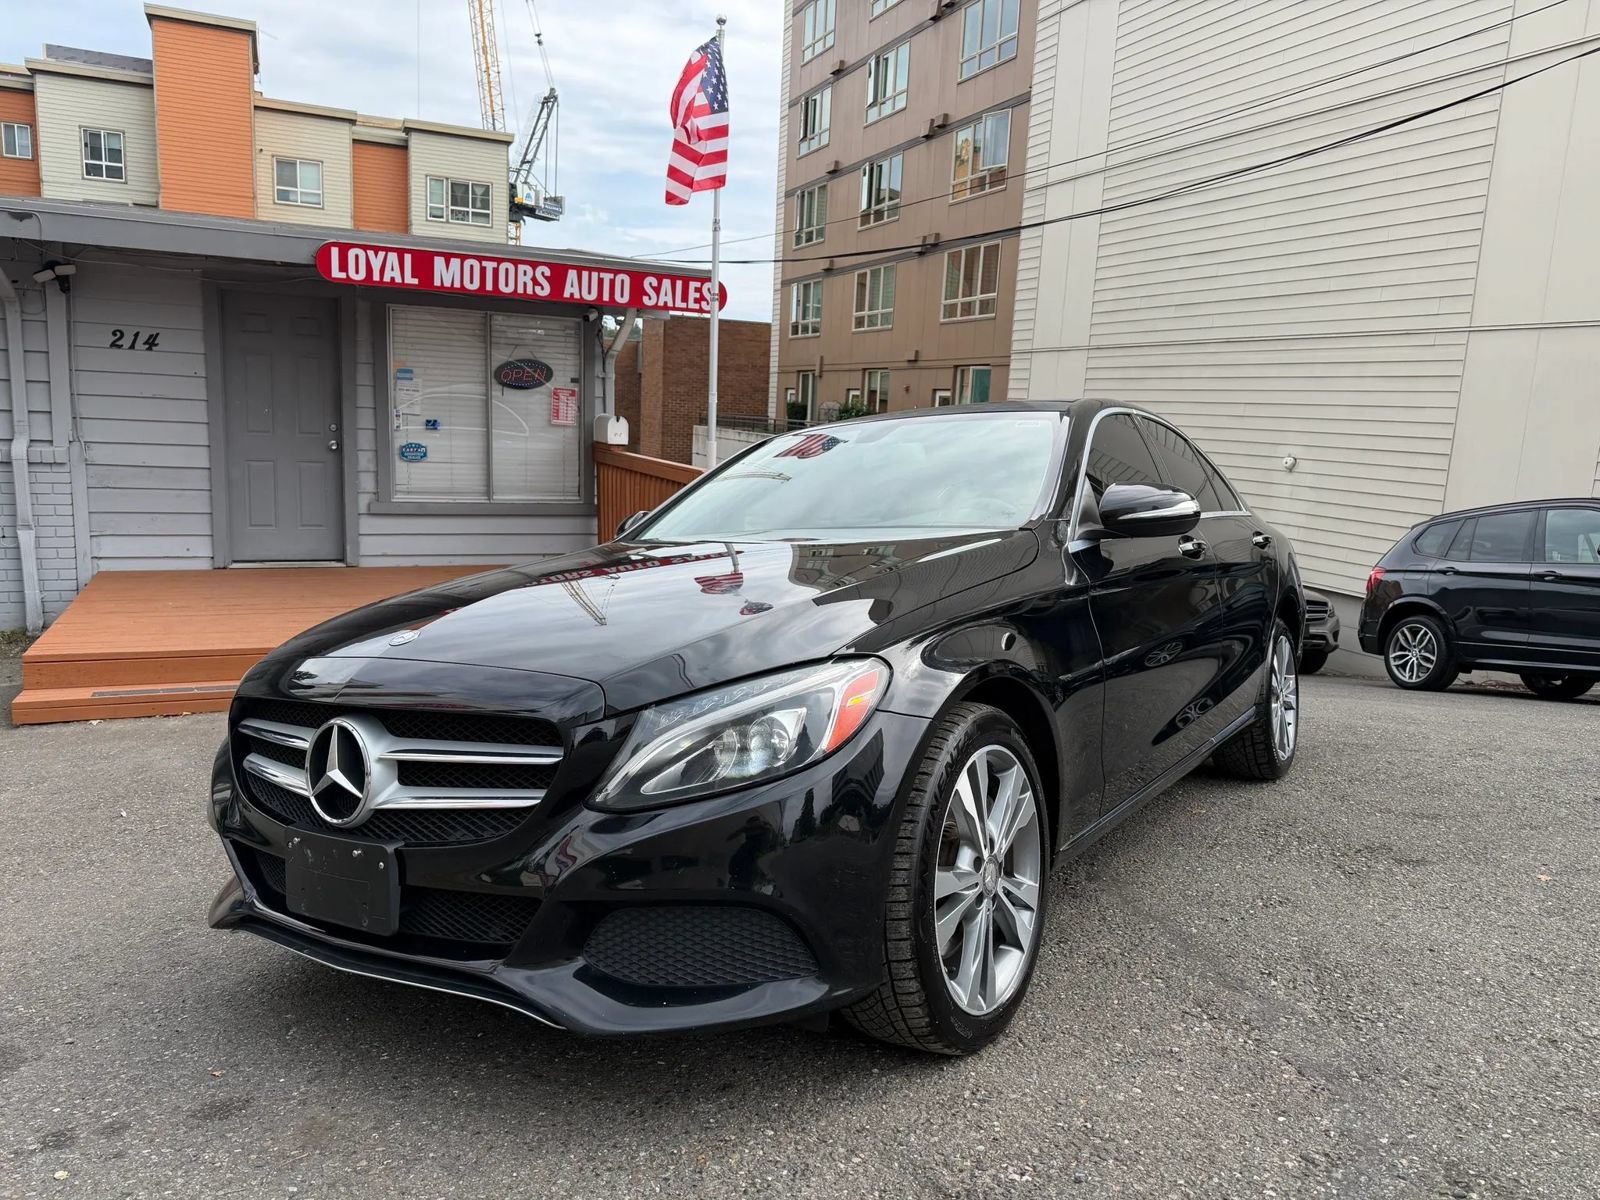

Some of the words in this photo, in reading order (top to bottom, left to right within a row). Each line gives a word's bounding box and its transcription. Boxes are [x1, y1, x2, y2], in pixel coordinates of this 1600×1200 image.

[331, 246, 418, 285] LOYAL
[433, 256, 551, 298] MOTORS
[563, 269, 631, 304] AUTO
[643, 276, 713, 311] SALES
[109, 329, 160, 351] 214
[501, 368, 547, 382] OPEN
